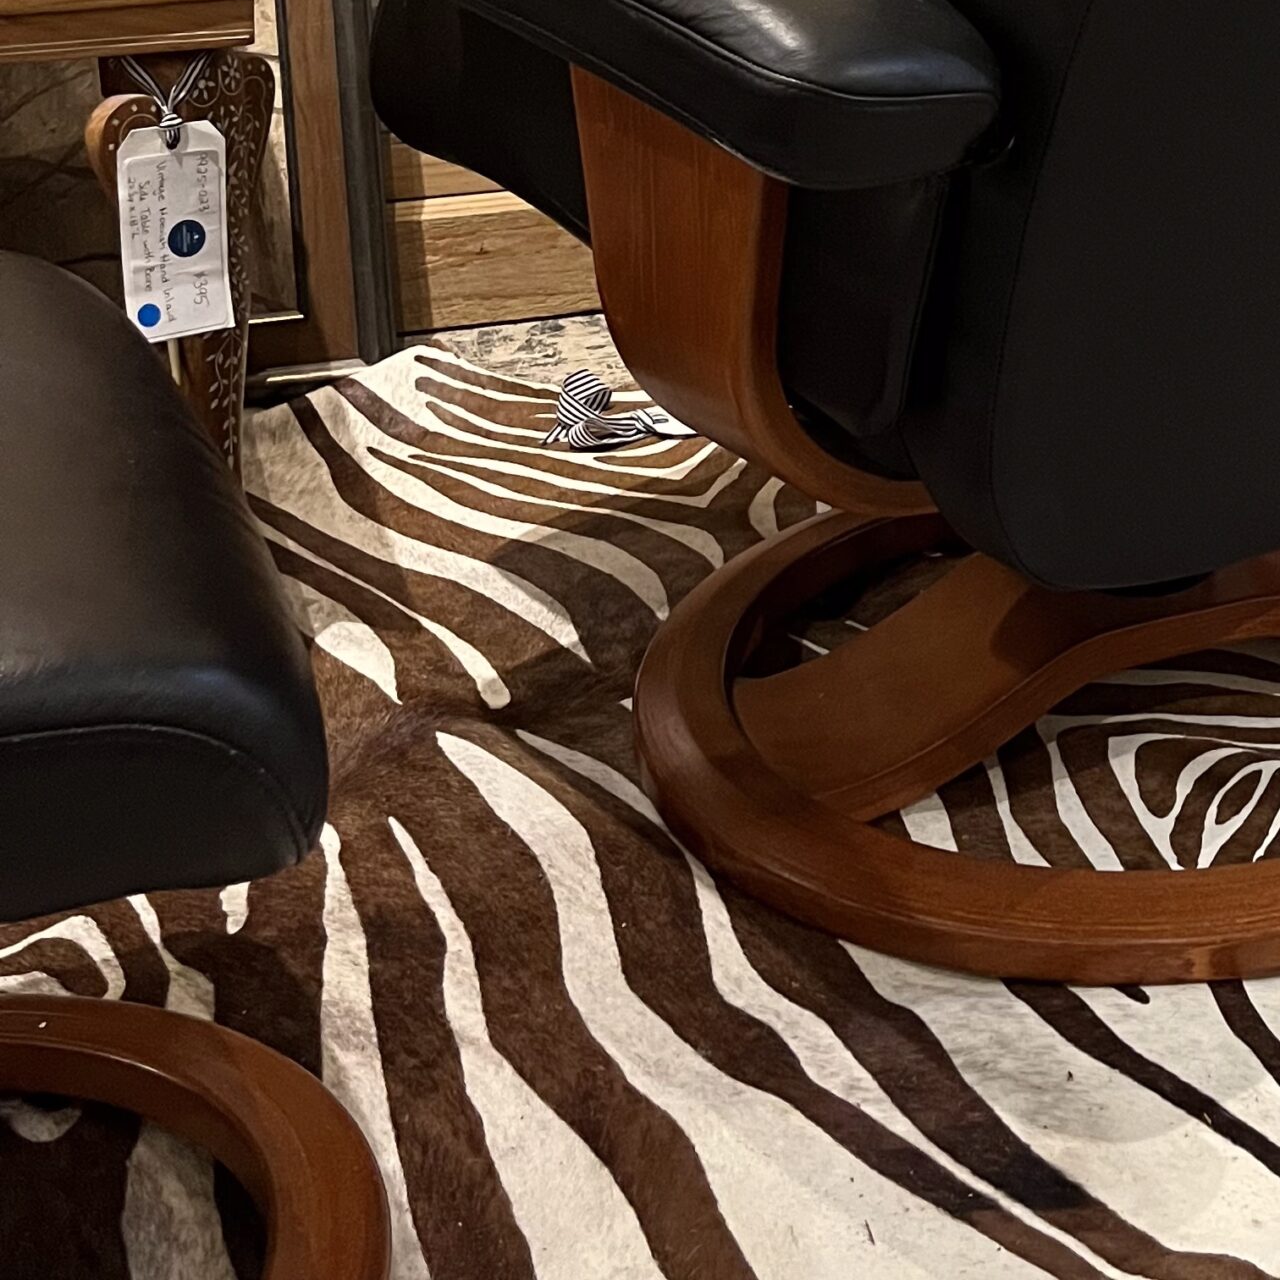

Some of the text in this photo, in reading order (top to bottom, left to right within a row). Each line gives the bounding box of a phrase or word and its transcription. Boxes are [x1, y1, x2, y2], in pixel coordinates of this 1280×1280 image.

[140, 208, 151, 235] Table
[159, 254, 172, 284] Hand
[193, 271, 210, 306] $395
